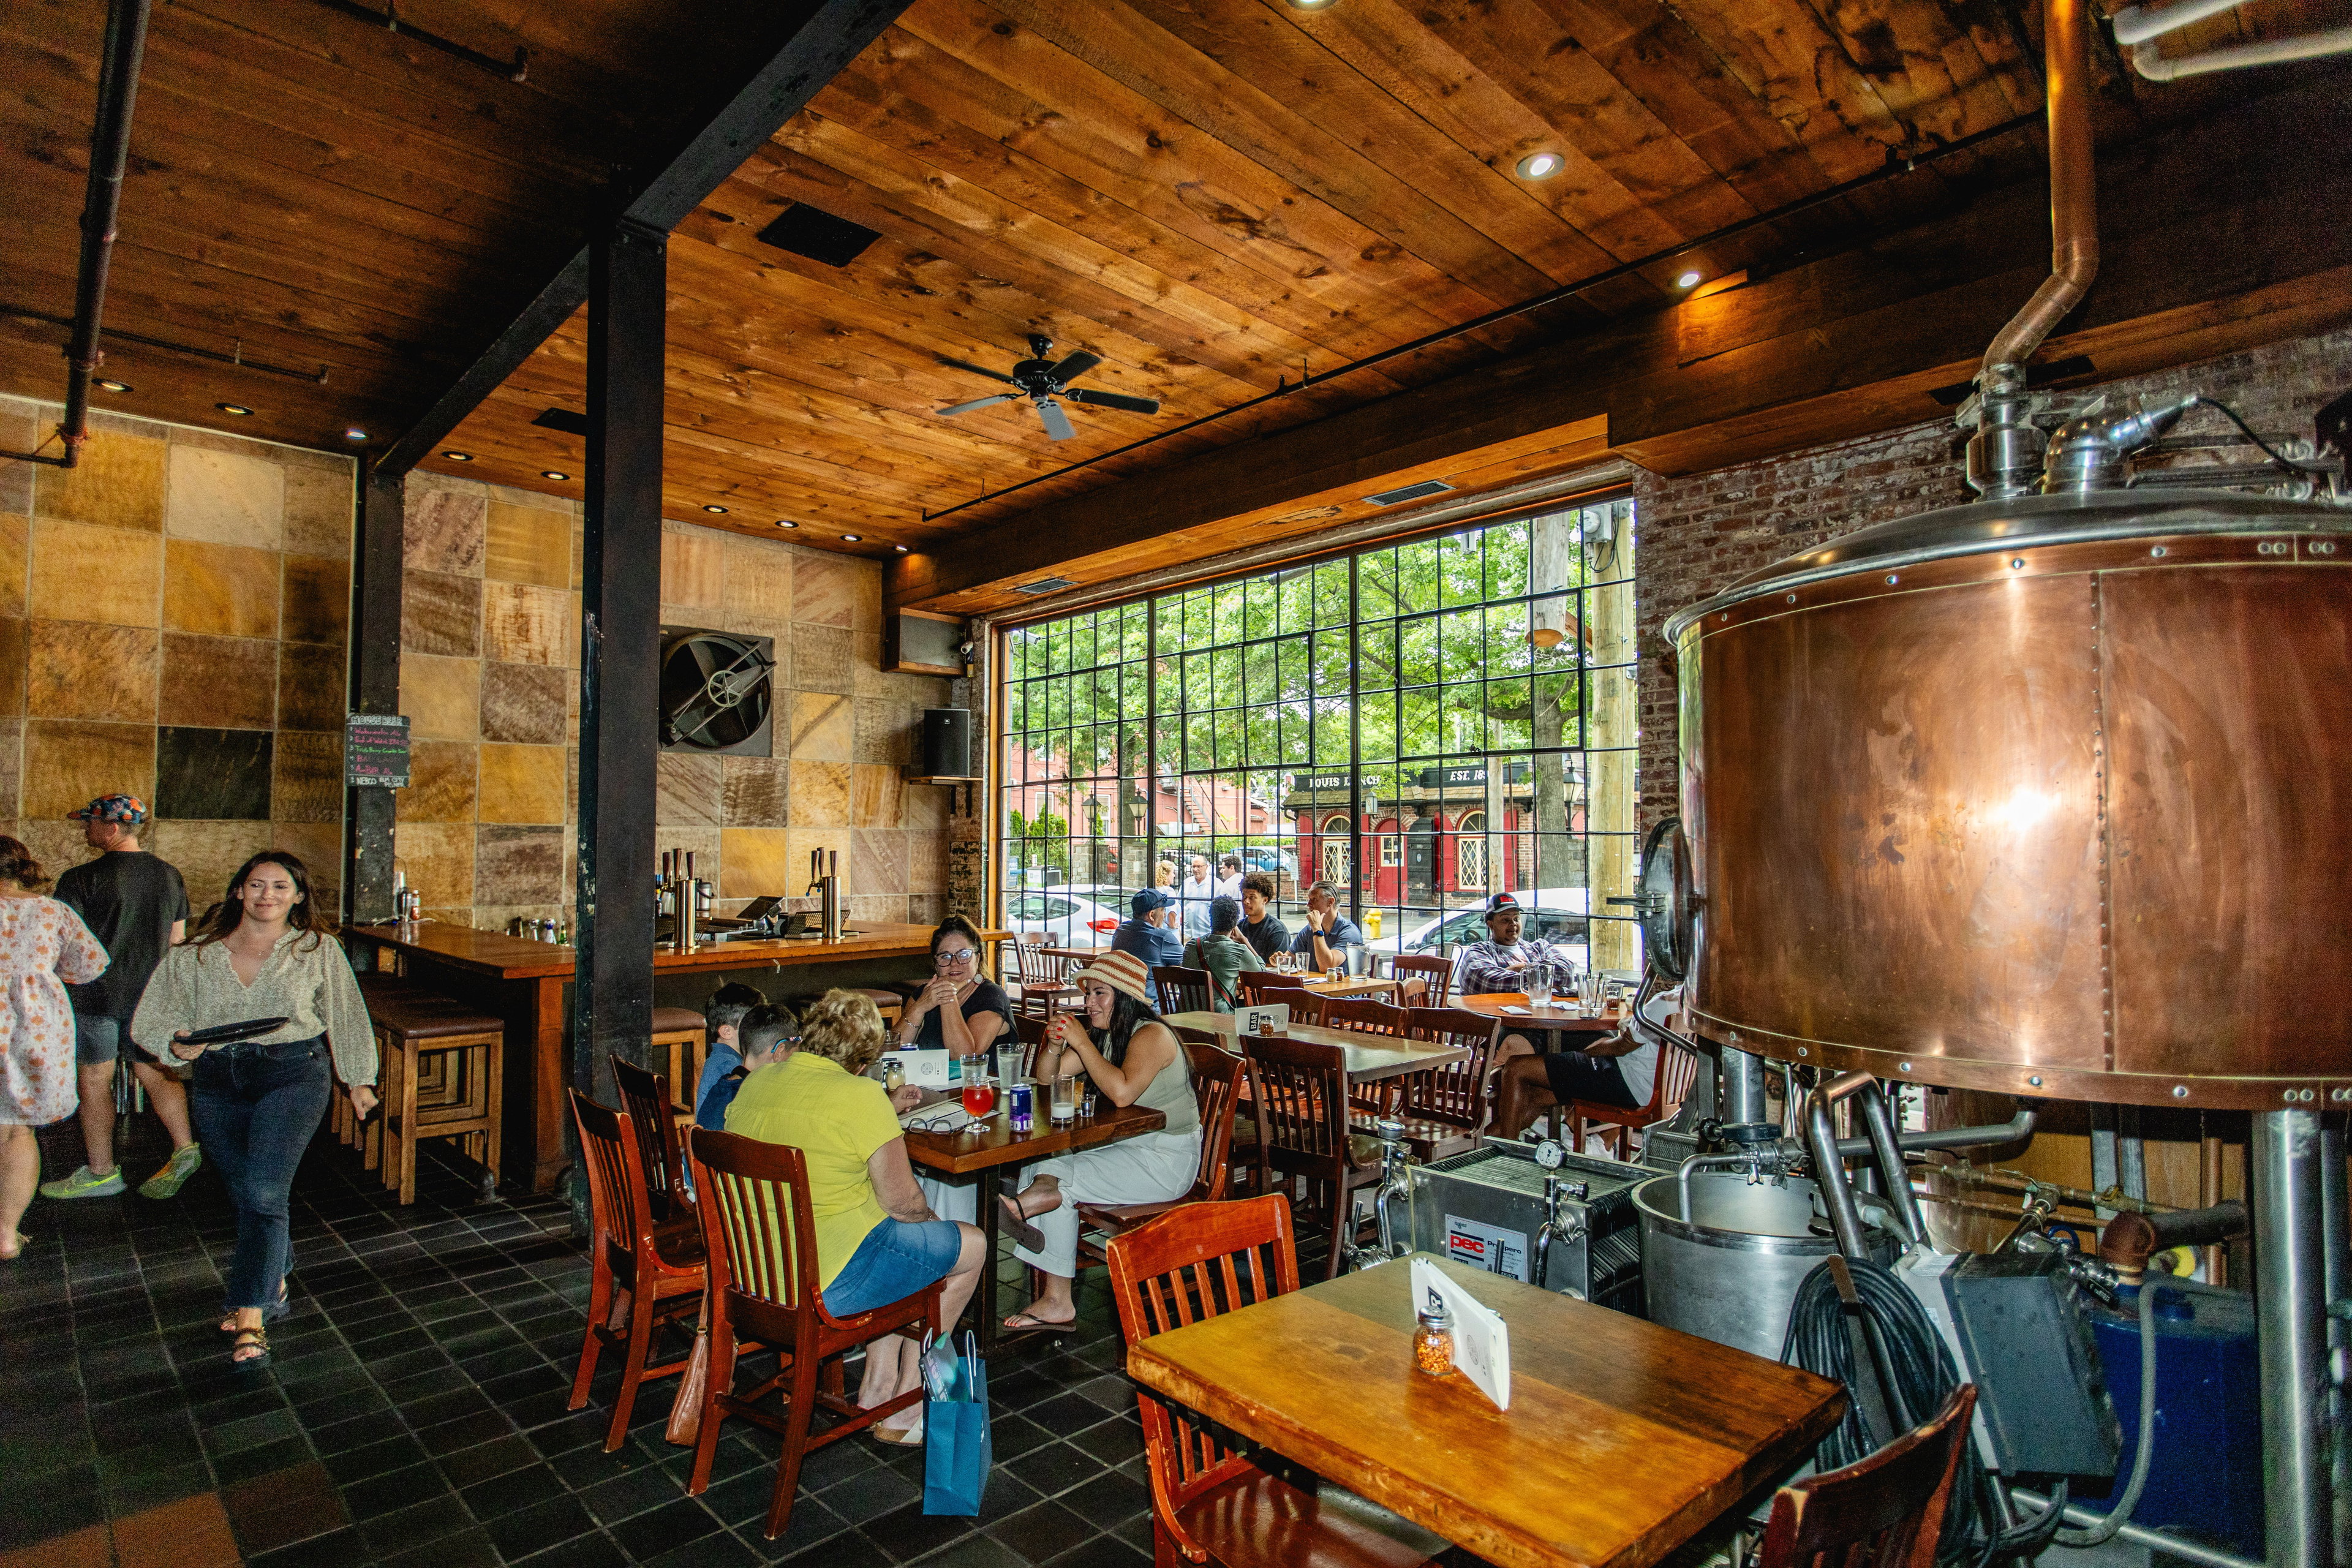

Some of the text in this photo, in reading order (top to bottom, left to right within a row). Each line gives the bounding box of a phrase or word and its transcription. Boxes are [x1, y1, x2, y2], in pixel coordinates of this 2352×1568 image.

[351, 715, 403, 726] HOUSE BEER
[1450, 770, 1470, 781] EST.
[1450, 1235, 1484, 1253] pec
[1487, 1241, 1521, 1254] Prpero
